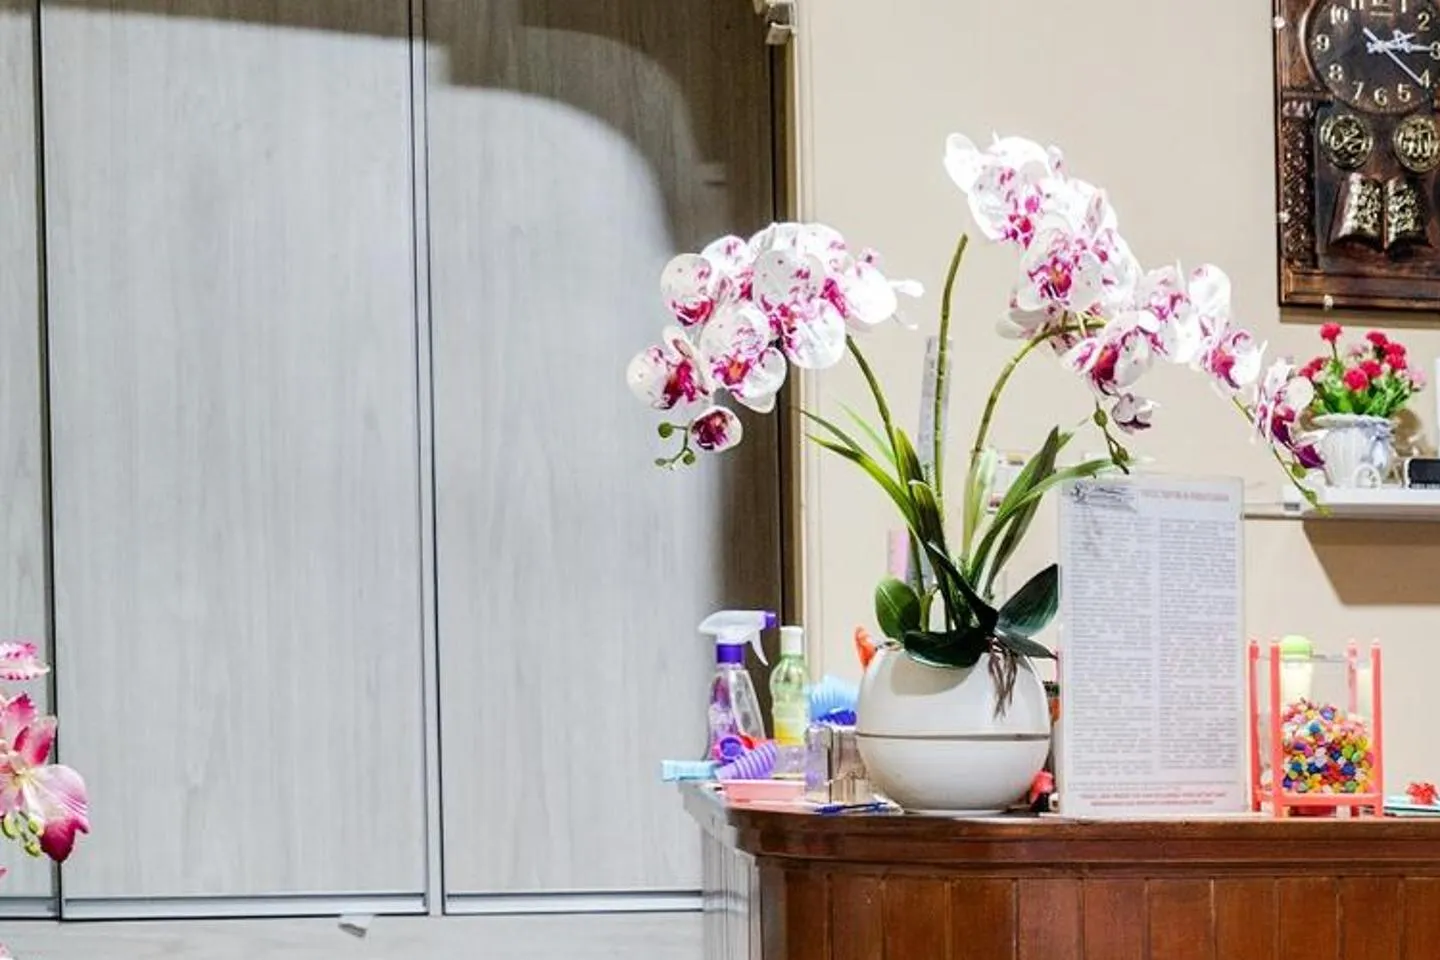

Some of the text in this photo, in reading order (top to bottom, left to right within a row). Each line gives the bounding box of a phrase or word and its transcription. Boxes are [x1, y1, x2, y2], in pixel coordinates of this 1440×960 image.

[1330, 5, 1349, 25] 10
[1418, 12, 1430, 31] 2
[1316, 34, 1330, 51] 9
[1329, 63, 1343, 81] 8
[1352, 81, 1364, 99] 7
[1374, 87, 1388, 105] 6
[1398, 83, 1410, 101] 5
